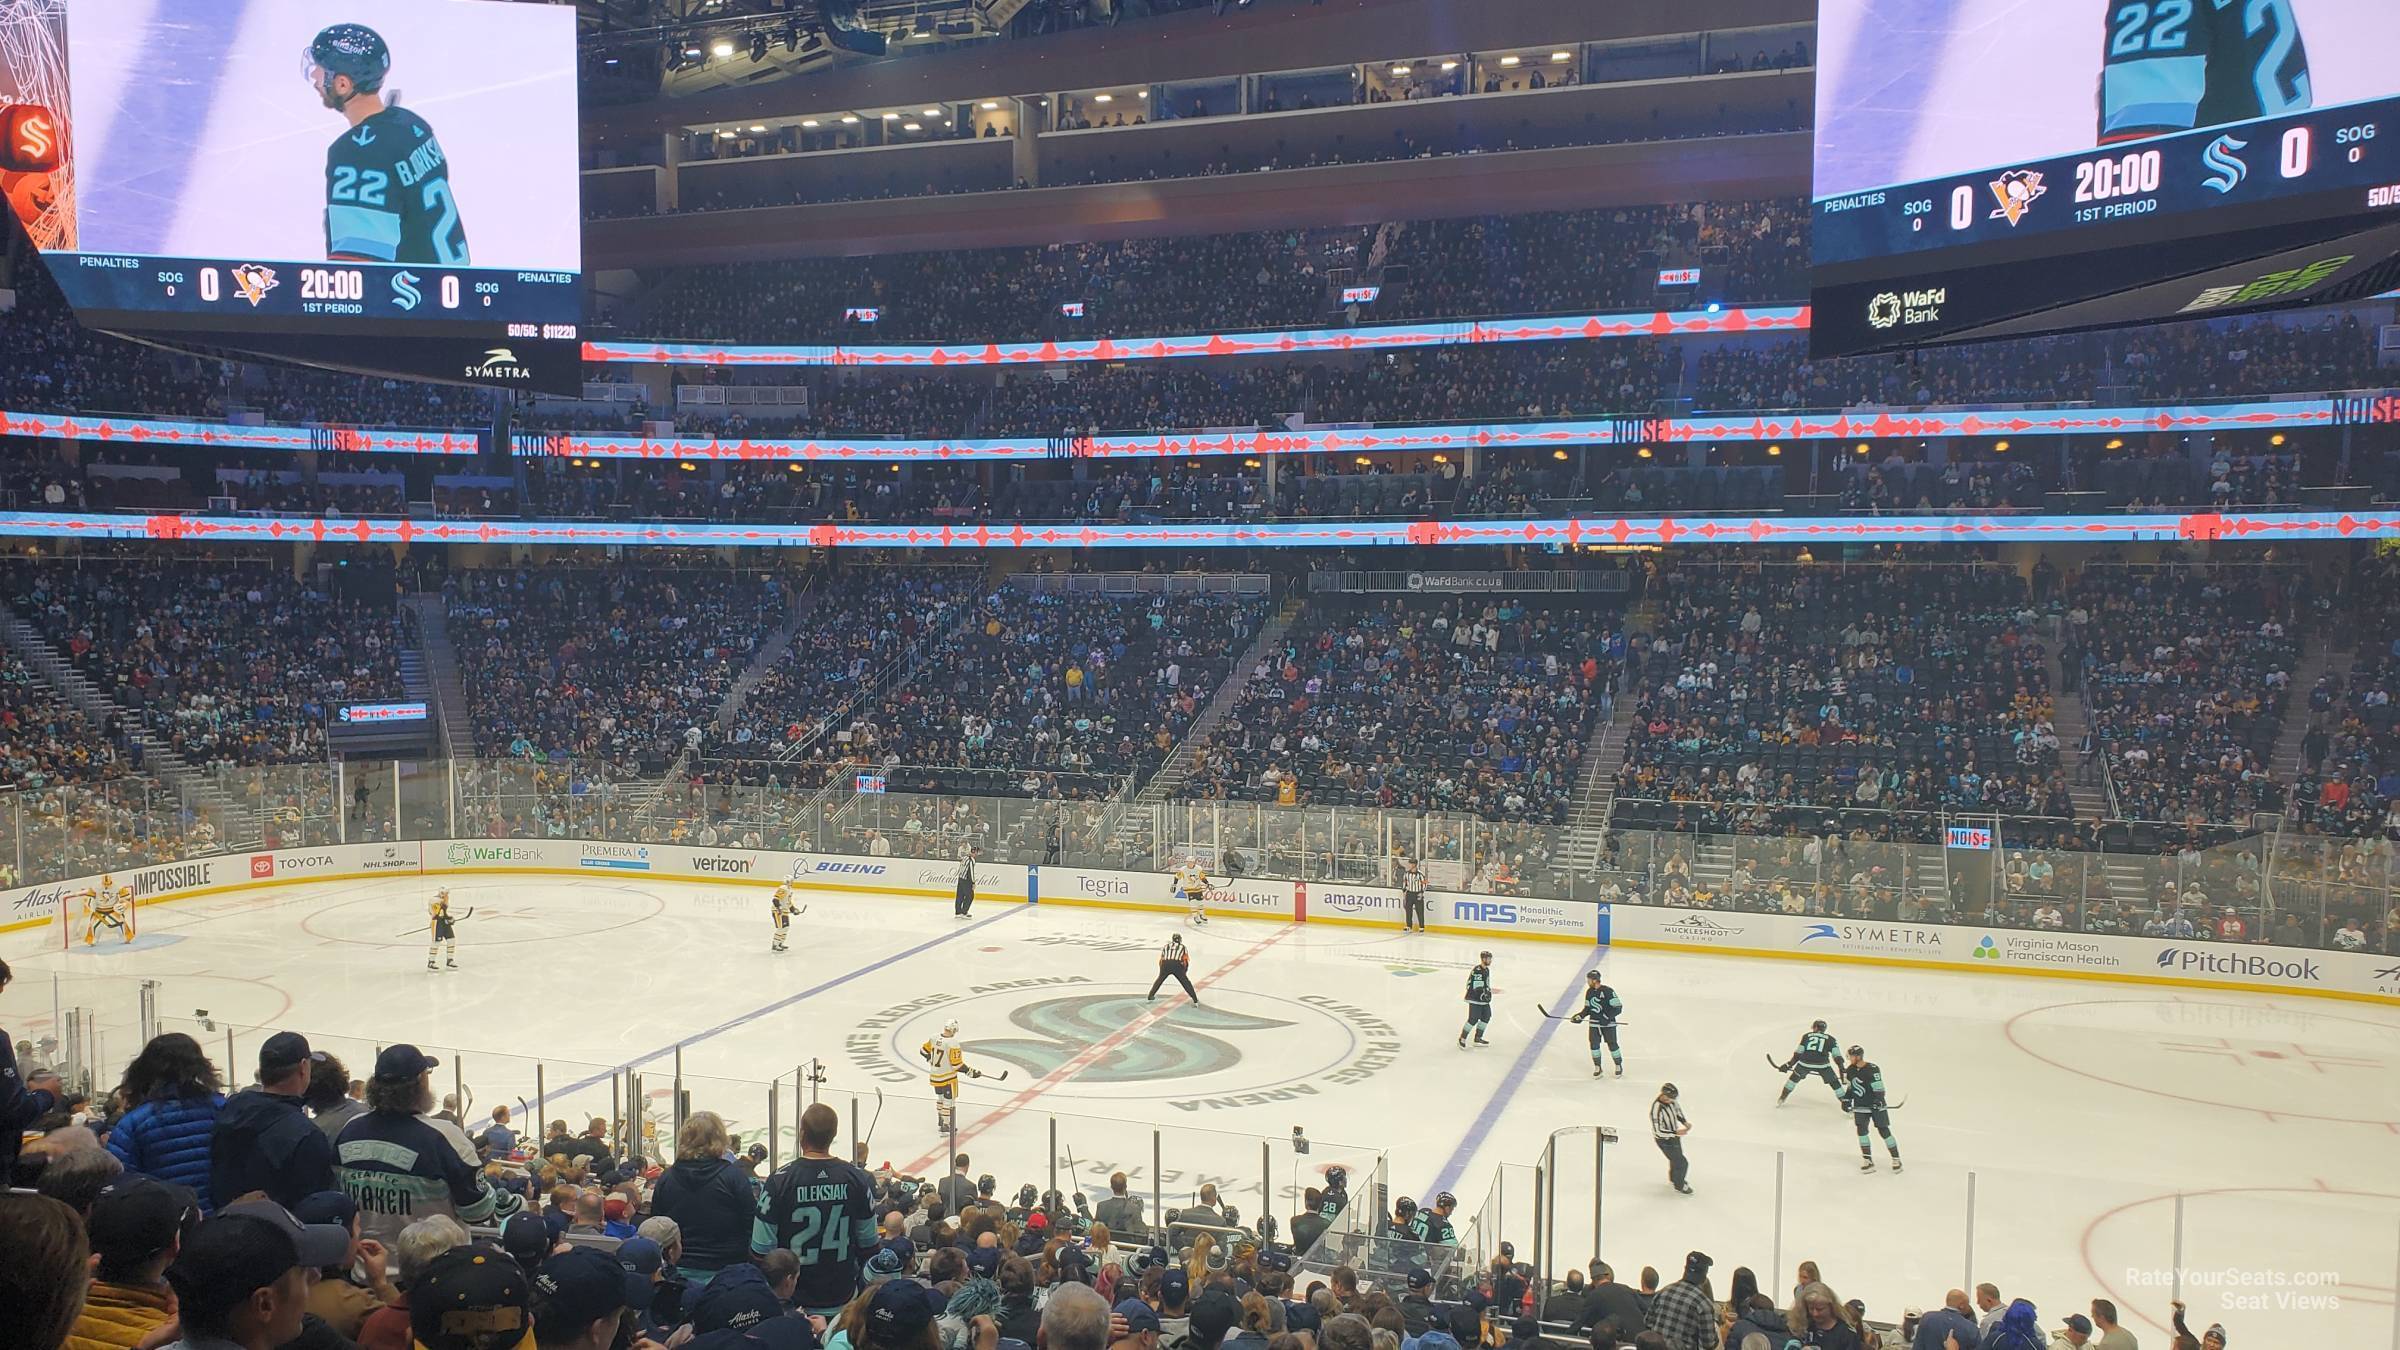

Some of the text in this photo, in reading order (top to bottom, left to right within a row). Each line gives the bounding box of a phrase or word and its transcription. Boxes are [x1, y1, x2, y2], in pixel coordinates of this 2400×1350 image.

[2111, 0, 2193, 56] 22
[2336, 124, 2376, 144] SOG
[2281, 127, 2310, 178] 0
[2348, 147, 2360, 163] 0
[2074, 150, 2160, 203] 20:00
[332, 166, 388, 206] 22
[1824, 192, 1886, 213] PENALTIES
[1904, 200, 1932, 215] SOG
[1951, 185, 1973, 230] 0
[2074, 199, 2157, 223] 1ST PERIOD
[1912, 218, 1922, 231] 0
[80, 257, 139, 269] PENALTIES
[158, 271, 184, 283] SOG
[200, 267, 219, 301] 0
[301, 269, 363, 300] 20:00
[517, 273, 572, 284] PENALTIES
[167, 286, 175, 297] 0
[441, 275, 460, 309] 0
[475, 282, 499, 293] SOG
[483, 296, 491, 306] 0
[1903, 288, 1945, 308] WaFd
[302, 303, 363, 314] 1ST PERIOD
[1904, 308, 1939, 324] Bank
[508, 324, 577, 339] 50/50: $11220
[465, 366, 530, 378] SYMETRA
[310, 429, 350, 451] NOISE
[1612, 419, 1665, 443] NOISE
[519, 436, 565, 457] NOISE
[1047, 436, 1089, 459] NOISE
[1951, 830, 1990, 847] NOISE
[582, 843, 632, 857] PREMERA
[279, 855, 334, 869] TOYOTA
[692, 855, 750, 873] verizon
[816, 861, 887, 875] BOEING
[133, 862, 211, 895] IMPOSSIBLE
[1077, 876, 1130, 897] Tegria
[1202, 888, 1280, 906] oors LIGHT
[1324, 892, 1382, 909] amazon
[1454, 902, 1517, 924] MPS
[1519, 905, 1564, 917] Monolithic
[1519, 916, 1585, 928] Power Systems
[1664, 926, 1729, 937] MUCKLESHOOT
[1842, 926, 1942, 946] SYMETRA
[2006, 937, 2099, 953] Virginia Mason
[2006, 949, 2120, 967] Franciscan Health
[2181, 951, 2320, 981] PitchBook
[846, 975, 1093, 1083] CLIMATE PLEDGE ARENA
[1166, 994, 1401, 1112] CLIMATE PLEDGE ARENA
[1806, 1036, 1826, 1053] 21
[930, 1047, 945, 1067] 17
[796, 1183, 849, 1203] OLEKSIAK
[1322, 1201, 1338, 1213] 28
[789, 1203, 851, 1266] 24
[728, 1309, 761, 1325] Alaska
